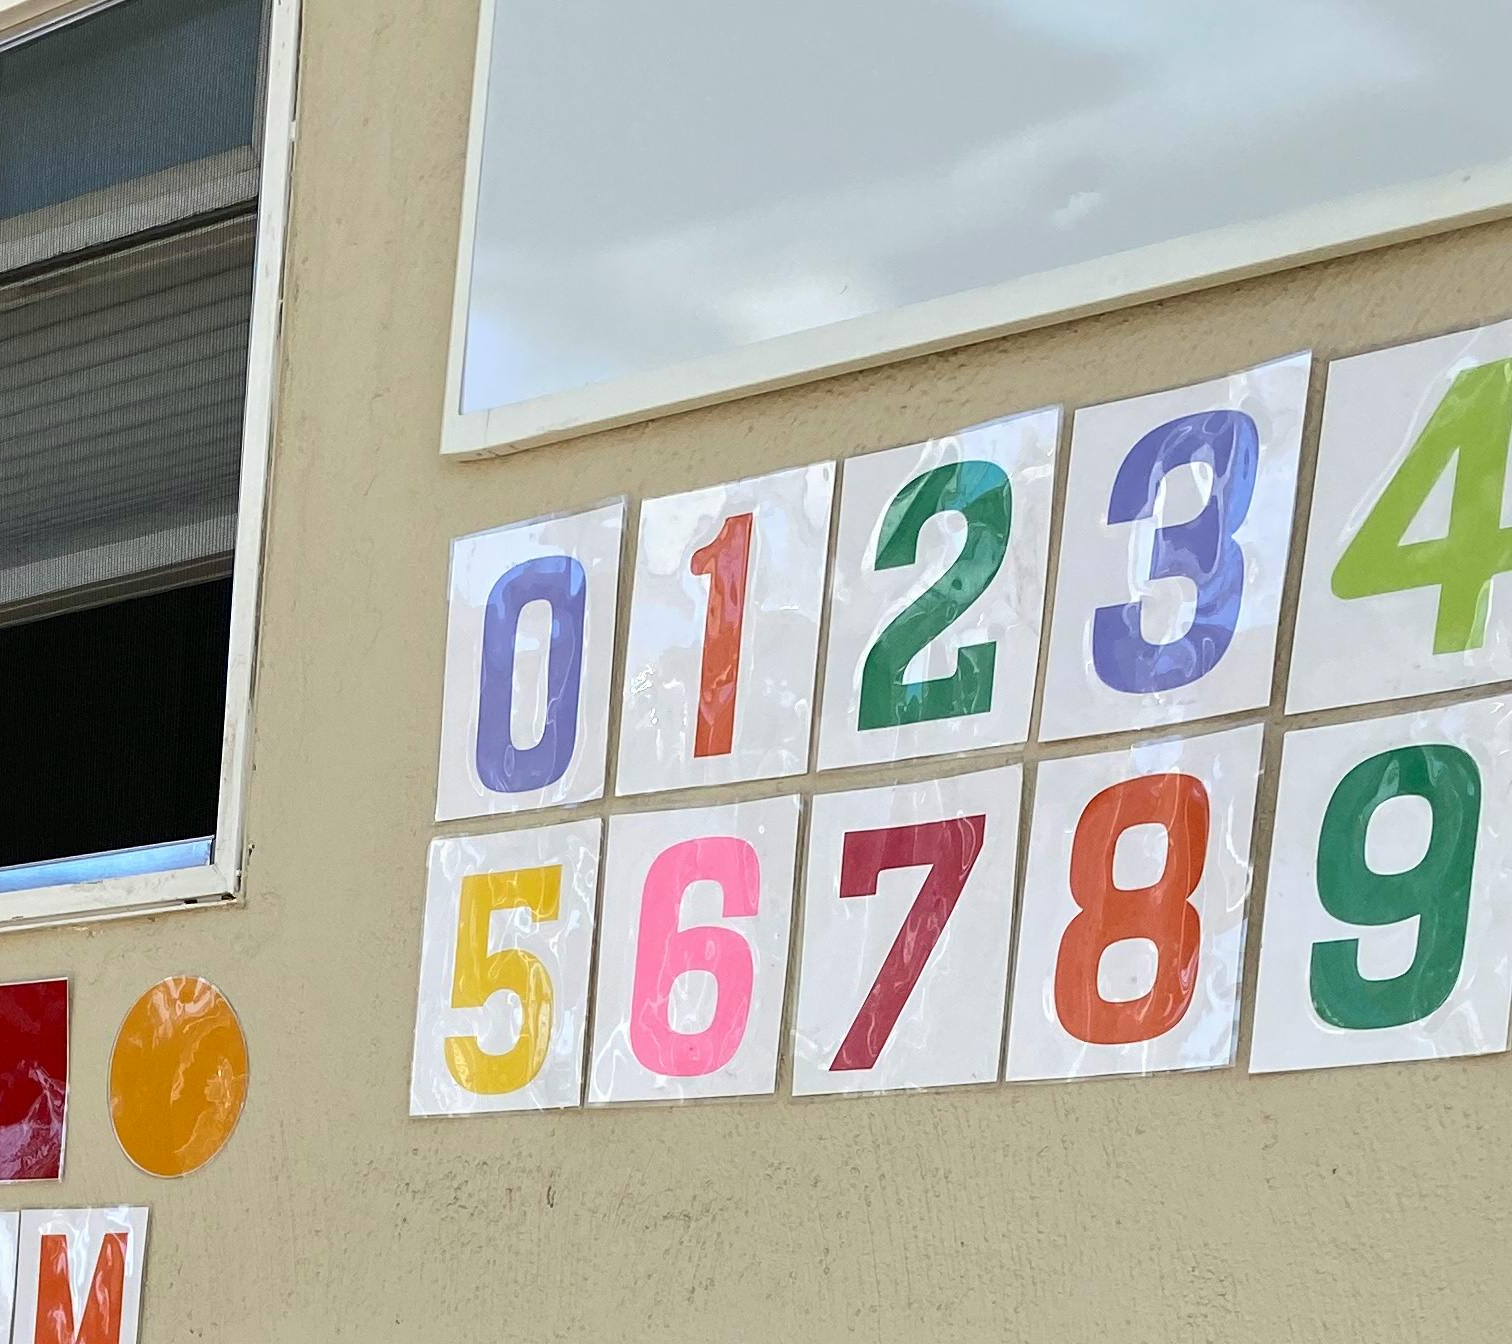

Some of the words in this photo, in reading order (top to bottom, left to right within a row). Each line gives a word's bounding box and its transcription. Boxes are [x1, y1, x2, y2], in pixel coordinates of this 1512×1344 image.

[475, 553, 587, 795] 0
[689, 511, 755, 760] 1
[856, 458, 1015, 733] 2
[1091, 407, 1260, 697] 3
[1329, 354, 1512, 657] 4
[443, 863, 564, 1096] 5
[628, 835, 762, 1079] 6
[827, 813, 987, 1074] 7
[1053, 771, 1211, 1046] 8
[1309, 741, 1483, 1032] 9
